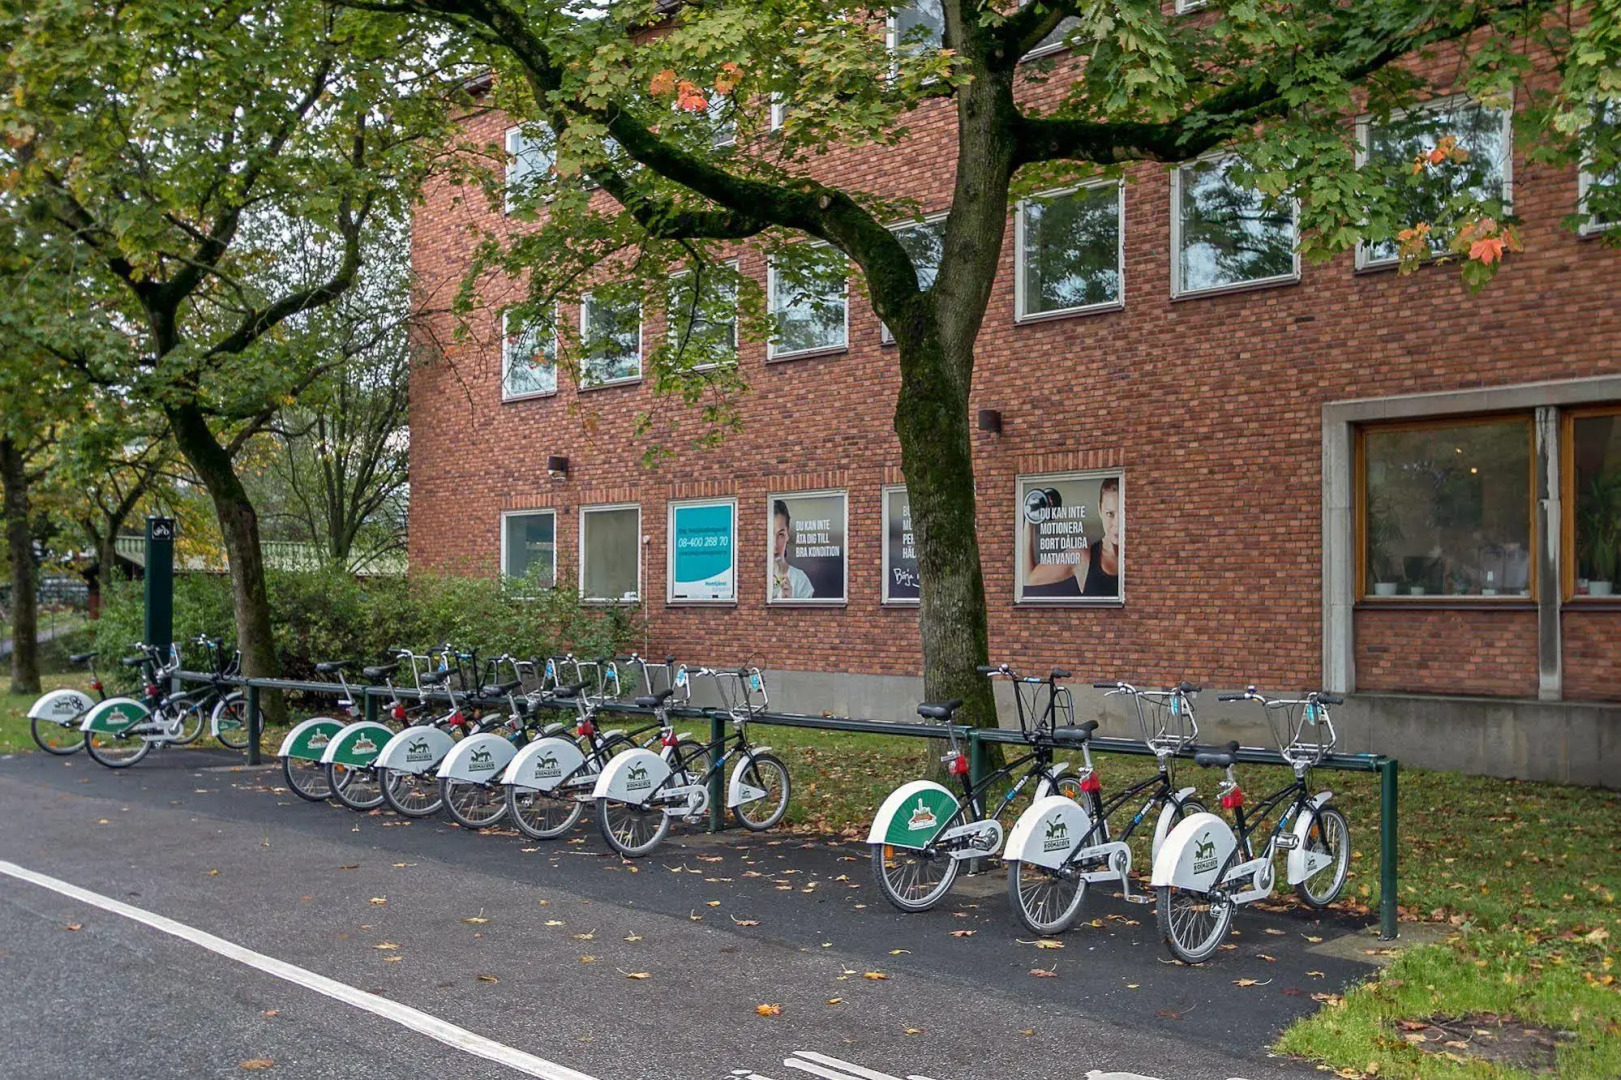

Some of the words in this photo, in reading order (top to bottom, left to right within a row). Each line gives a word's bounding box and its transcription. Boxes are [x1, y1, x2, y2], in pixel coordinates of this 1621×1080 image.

[1040, 508, 1050, 519] DU
[1052, 507, 1067, 519] KAN
[1068, 506, 1086, 518] INTE
[817, 519, 830, 530] INTE
[1040, 521, 1083, 535] MOTIONERA
[678, 537, 703, 548] 08-400
[704, 536, 718, 547] 268
[719, 536, 729, 546] 70
[817, 532, 830, 543] TILL
[1040, 537, 1060, 550] BORT
[1060, 534, 1088, 550] DÅLIGA
[796, 547, 808, 557] BRA
[808, 545, 840, 557] KONDITION
[1040, 552, 1080, 565] MATVANOR
